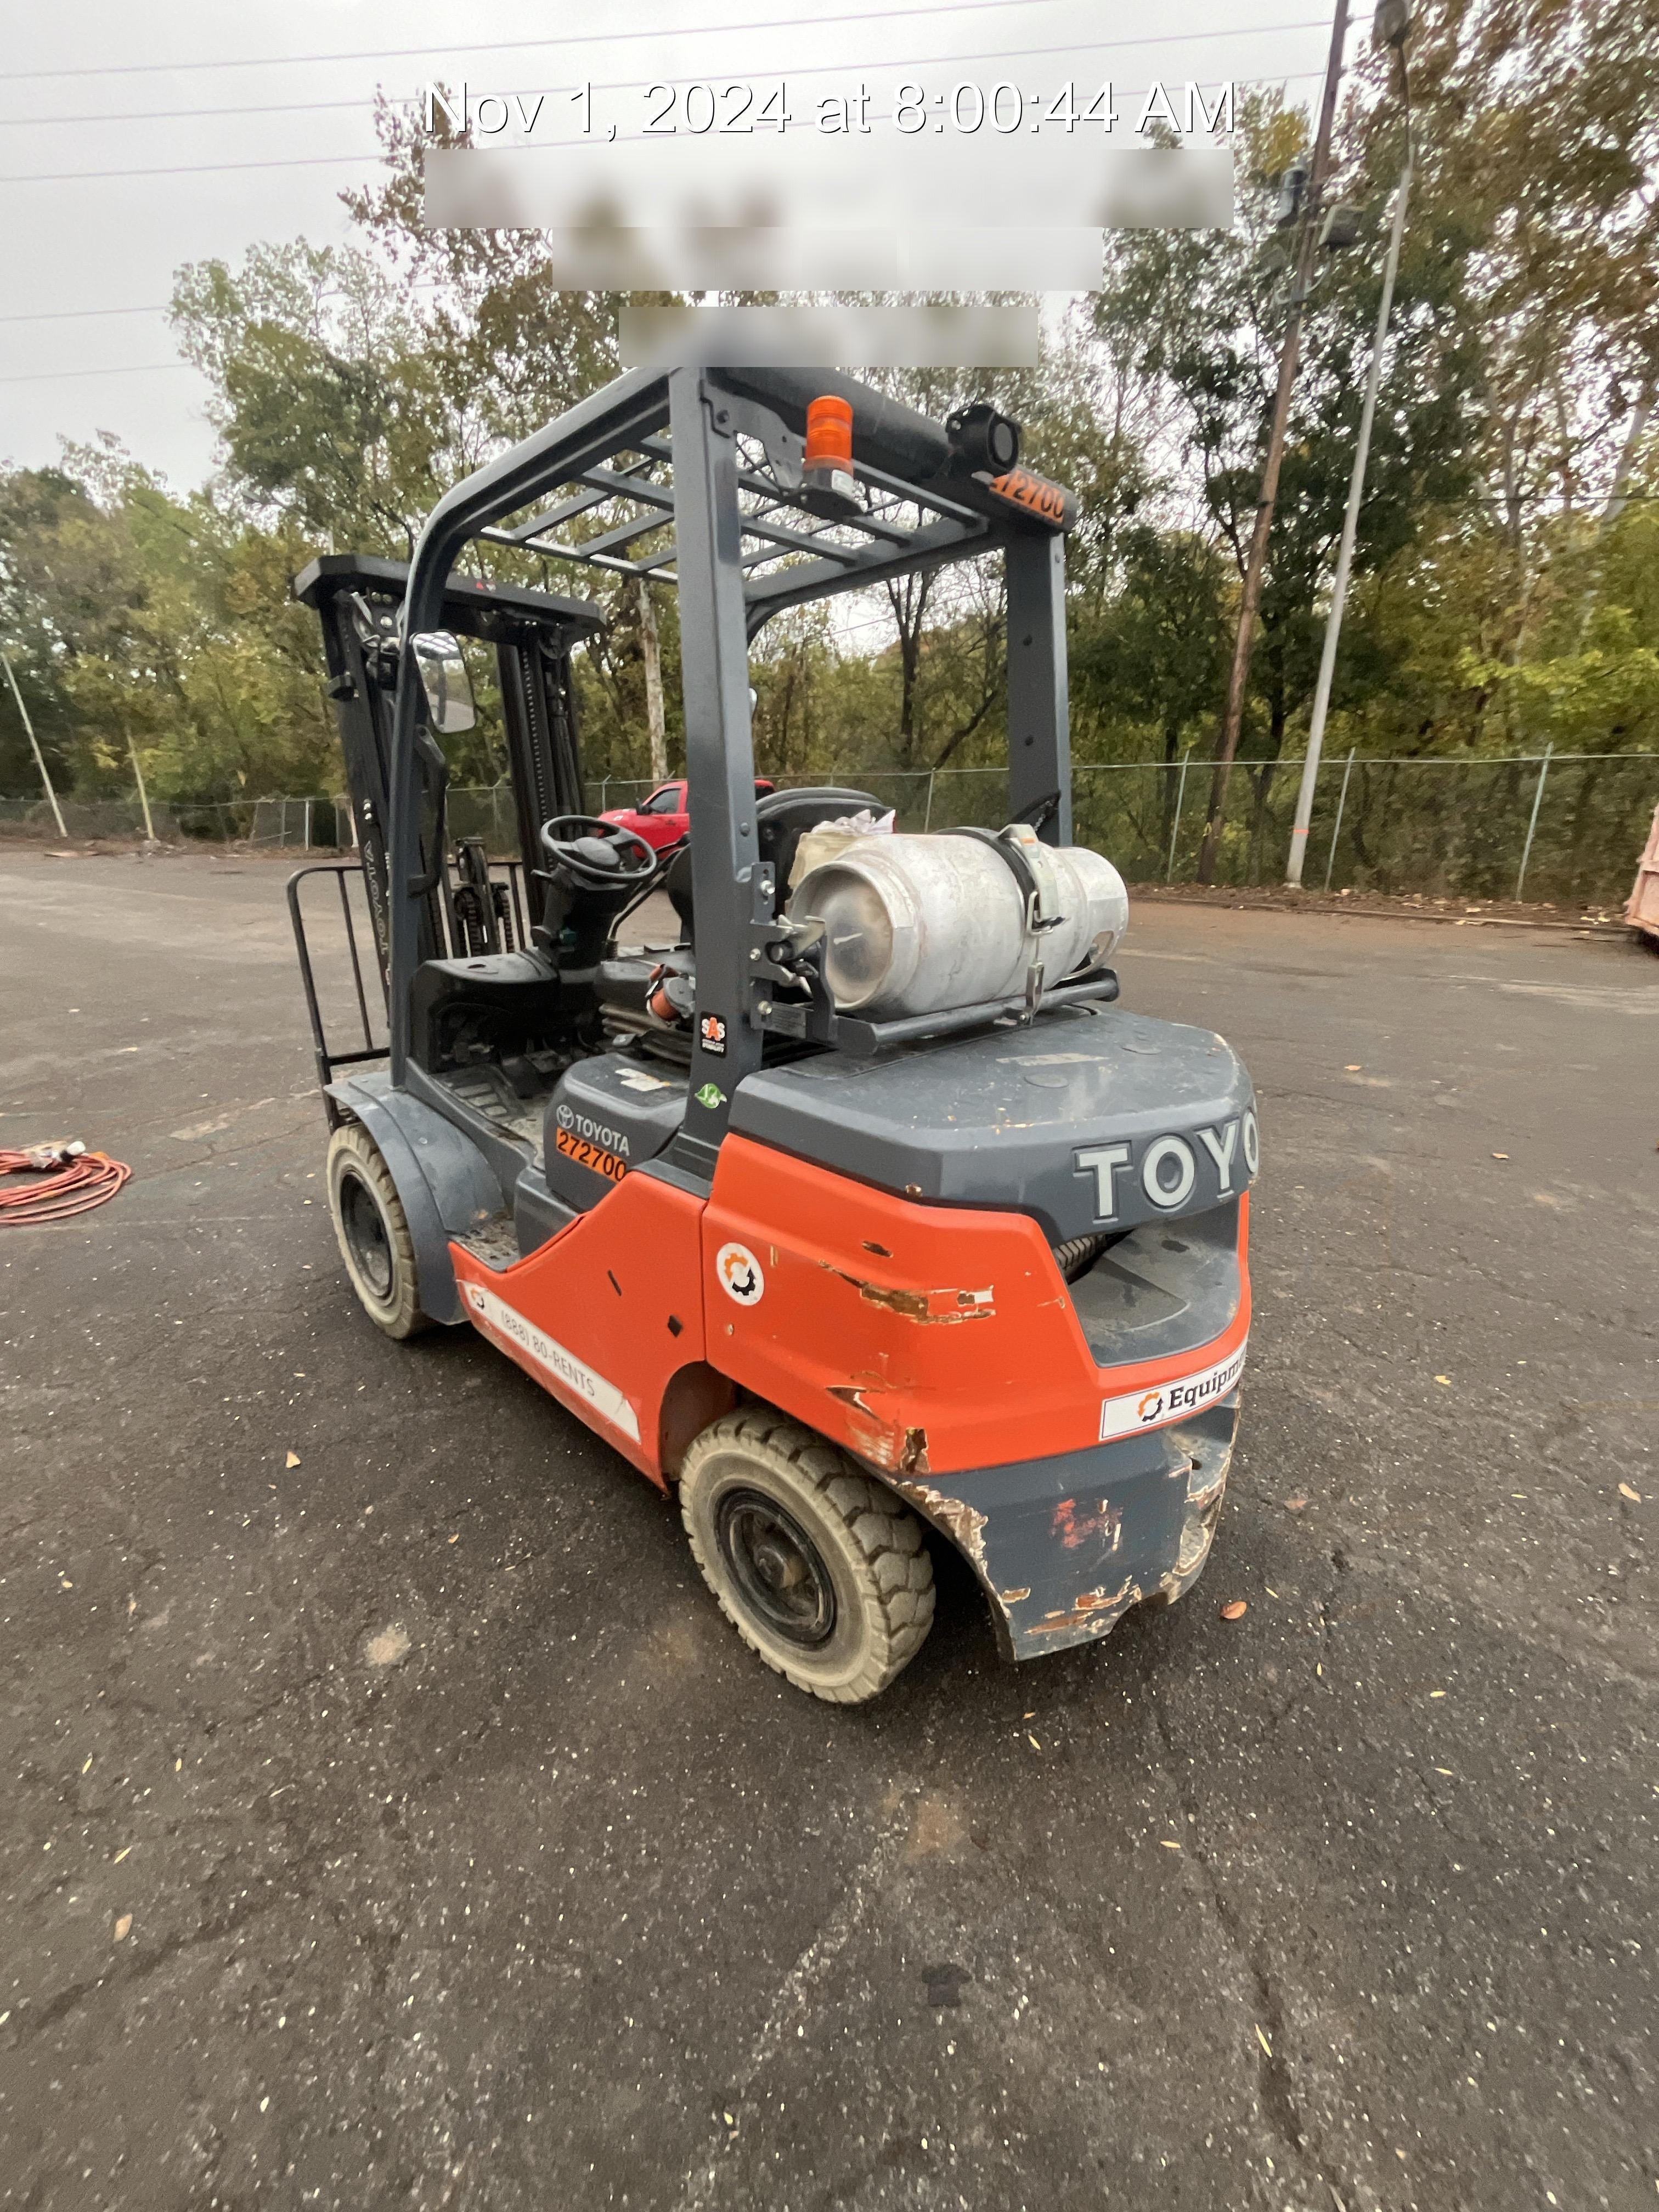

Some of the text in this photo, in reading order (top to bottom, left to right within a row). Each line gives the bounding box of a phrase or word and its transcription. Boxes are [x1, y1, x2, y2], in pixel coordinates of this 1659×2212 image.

[990, 473, 1064, 518] 72700
[701, 1017, 725, 1041] SAS
[557, 1131, 627, 1182] 272700
[575, 1114, 630, 1156] TOYOTA
[501, 1310, 595, 1397] (888) 80-RENTS
